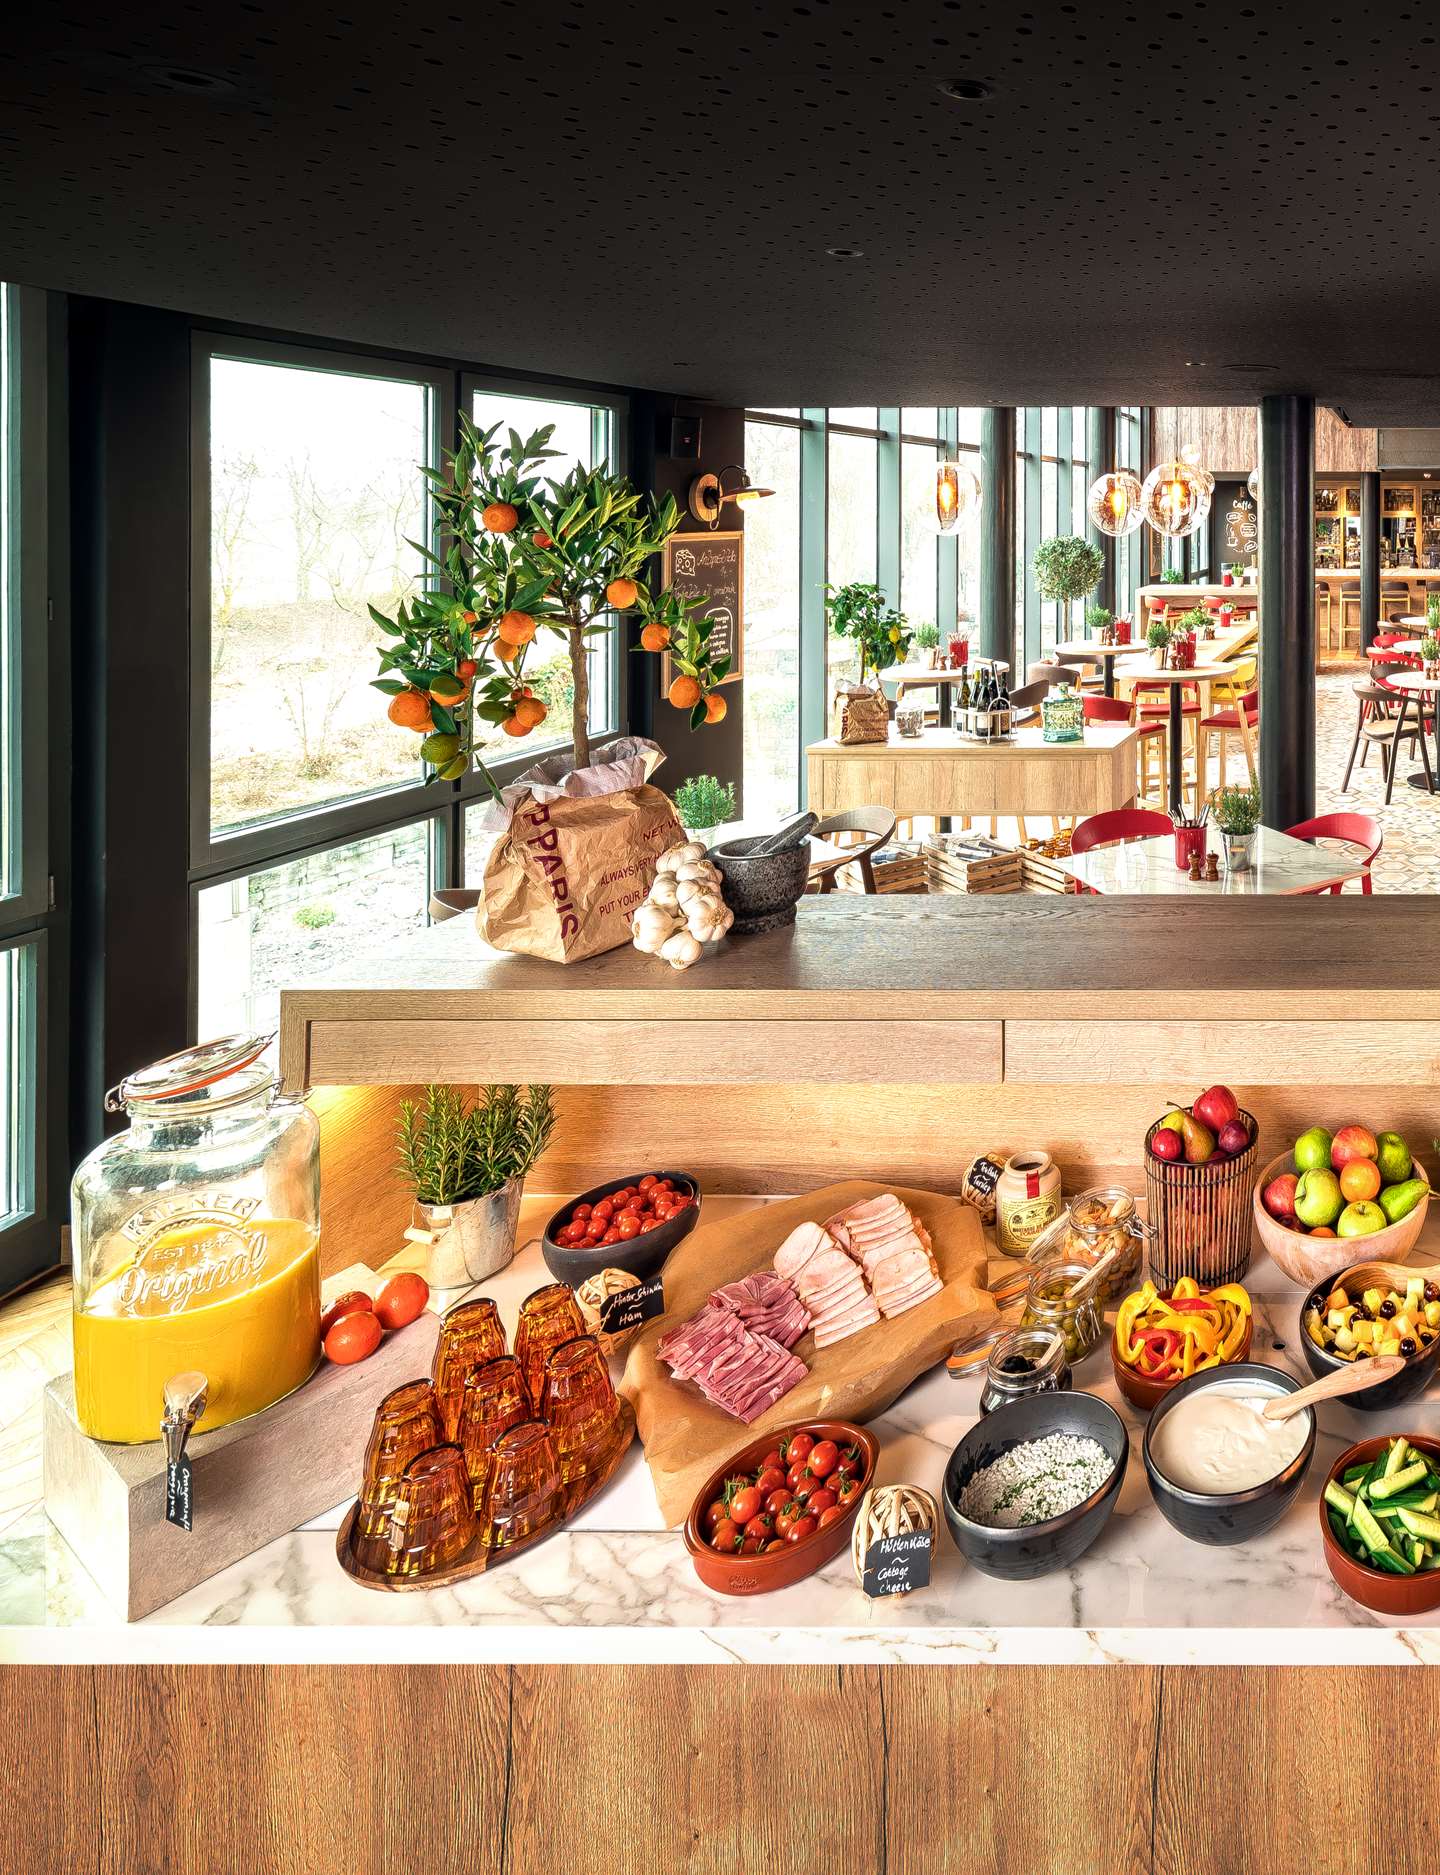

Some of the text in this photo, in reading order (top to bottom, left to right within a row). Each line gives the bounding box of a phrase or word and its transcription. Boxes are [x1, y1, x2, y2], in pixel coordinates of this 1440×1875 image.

[643, 824, 665, 842] NET
[600, 865, 635, 888] ALWAYS
[634, 855, 653, 873] VERY
[599, 901, 615, 918] PUT
[617, 890, 640, 908] YOUR
[127, 1193, 259, 1236] KILNER
[118, 1231, 268, 1315] Original
[618, 1312, 643, 1326] Ham
[877, 1566, 909, 1581] Cottage
[879, 1580, 912, 1594] cheese
